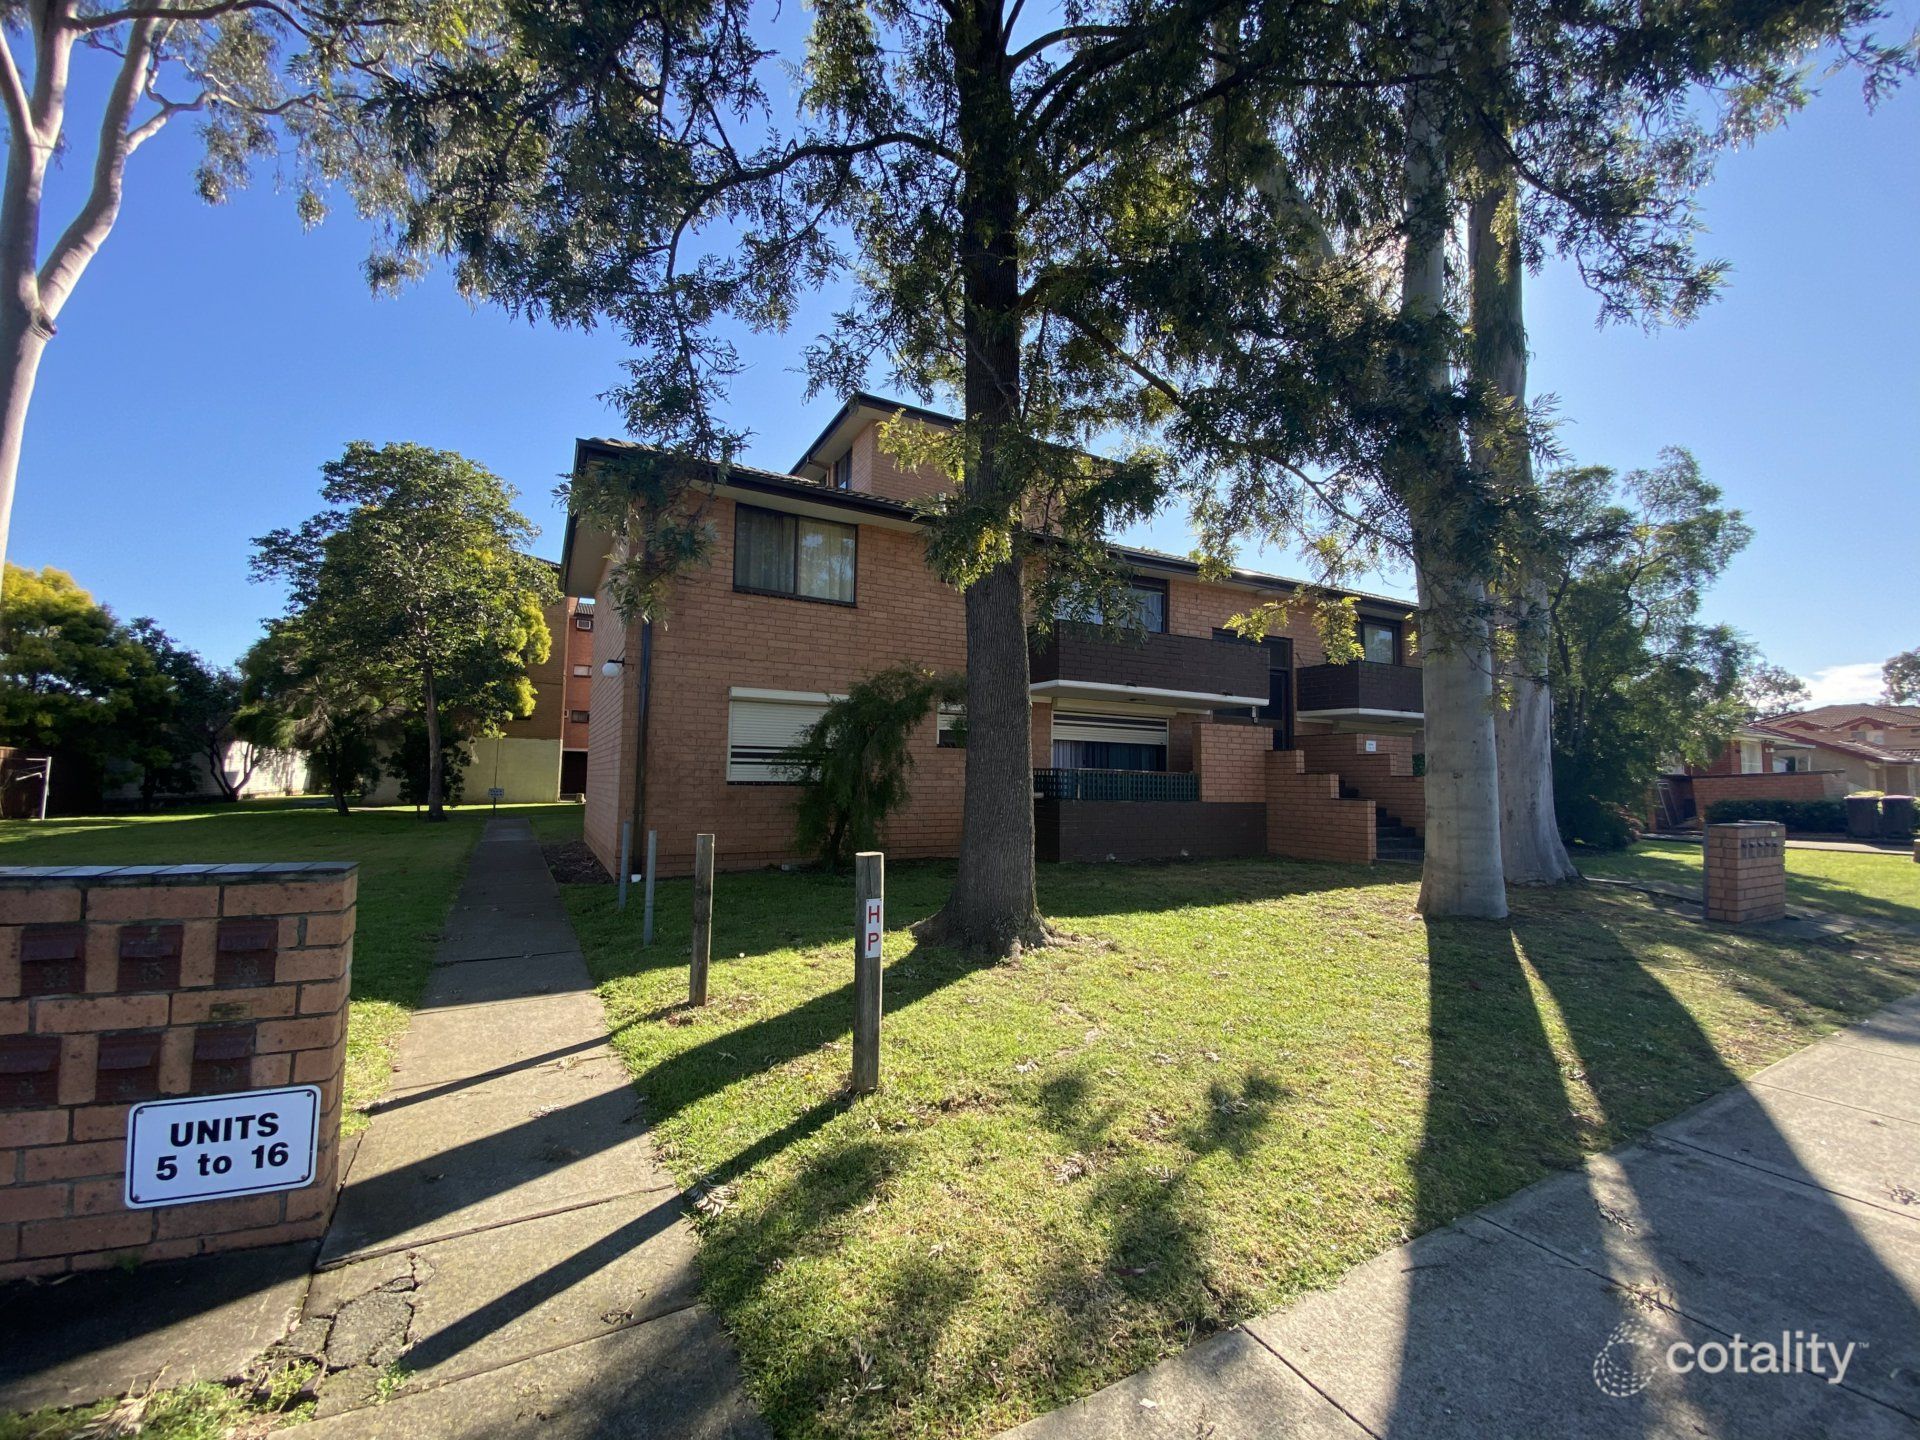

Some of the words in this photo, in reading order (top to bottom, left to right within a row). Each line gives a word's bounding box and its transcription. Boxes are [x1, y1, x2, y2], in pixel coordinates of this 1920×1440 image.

[170, 1112, 279, 1147] UNITS
[156, 1155, 178, 1181] 5
[198, 1151, 232, 1177] to
[251, 1142, 289, 1169] 16
